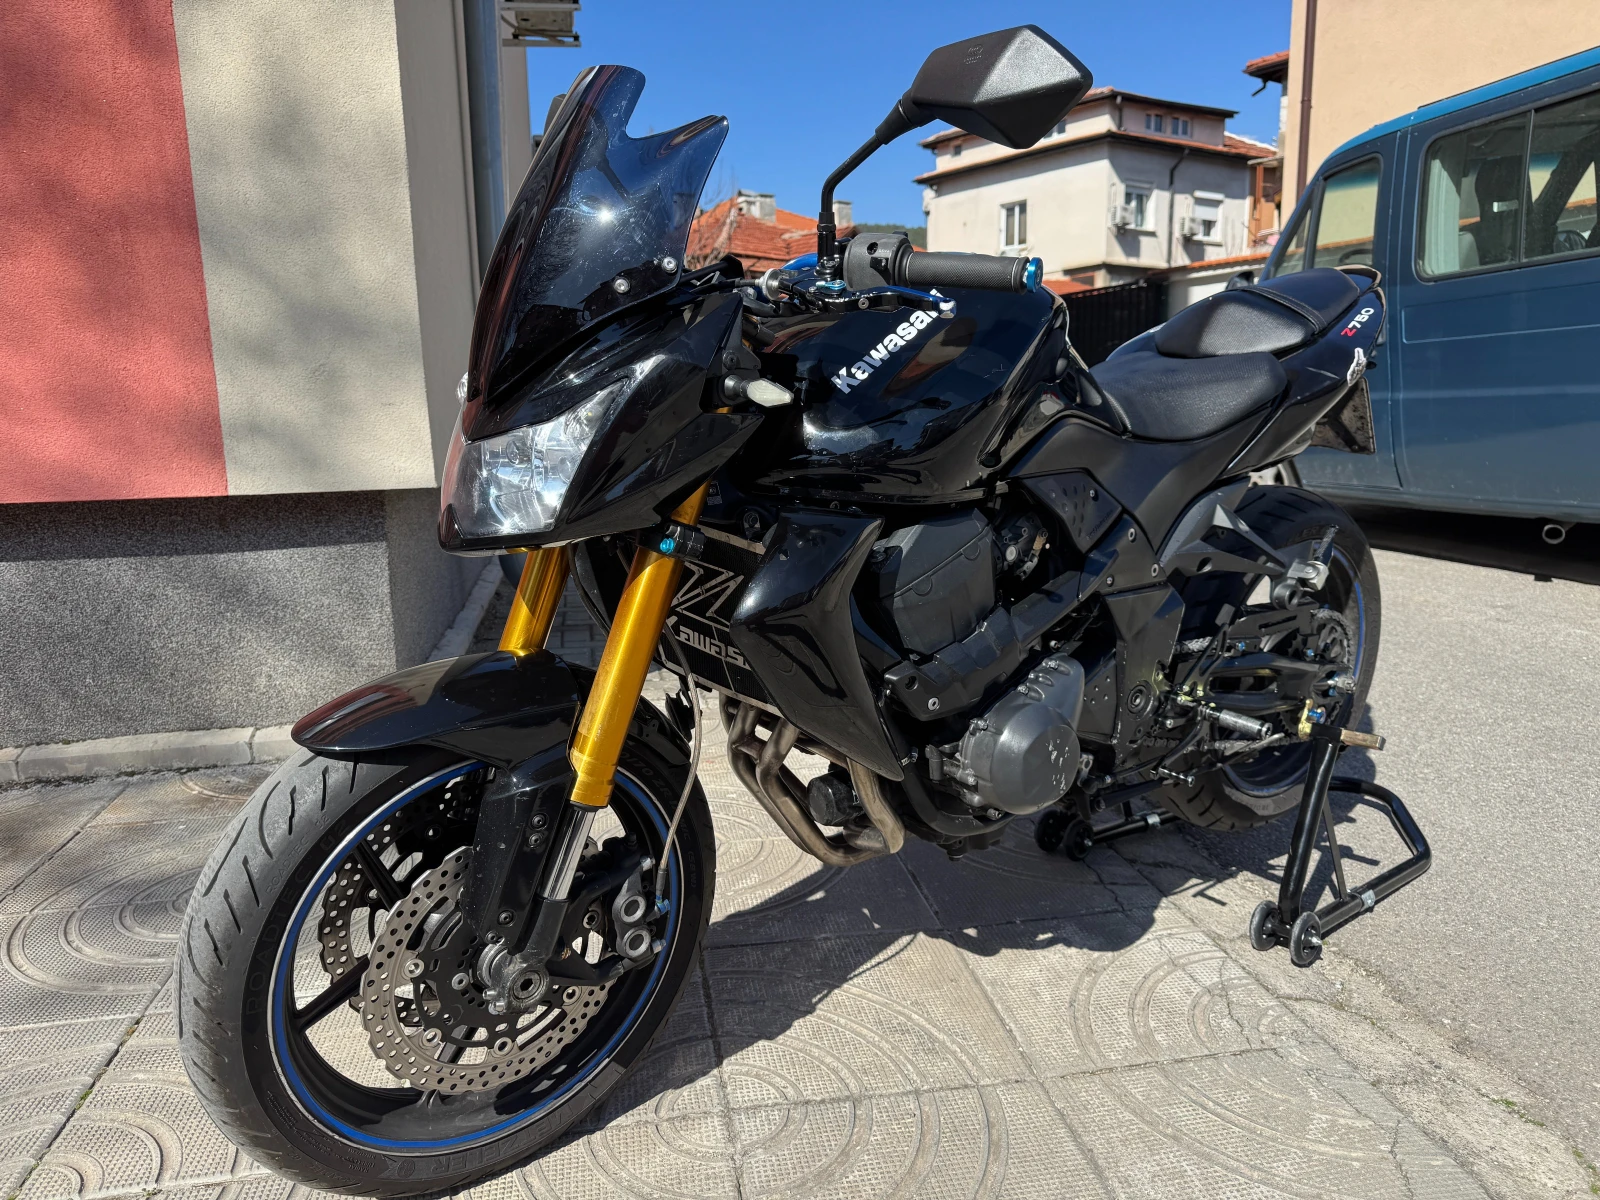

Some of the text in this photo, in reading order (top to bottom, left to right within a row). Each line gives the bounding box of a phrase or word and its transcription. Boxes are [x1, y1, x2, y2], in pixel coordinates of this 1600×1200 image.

[1341, 307, 1375, 337] Z750
[245, 865, 313, 1016] ROADTEC
[430, 1103, 574, 1176] METZELER
